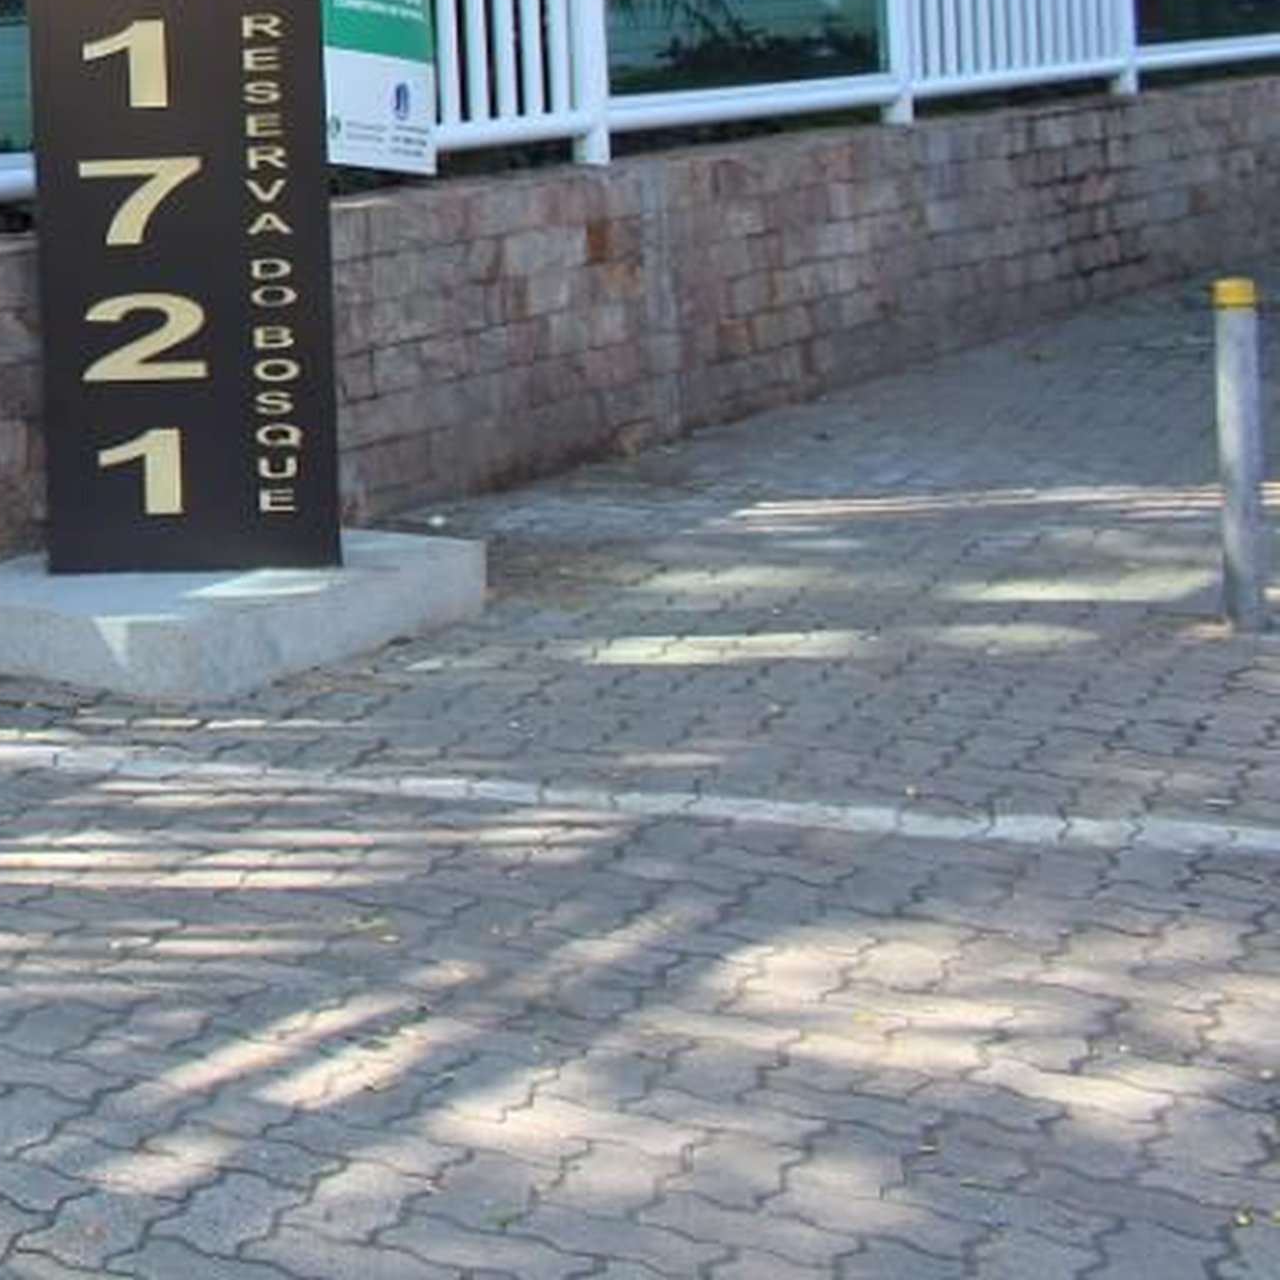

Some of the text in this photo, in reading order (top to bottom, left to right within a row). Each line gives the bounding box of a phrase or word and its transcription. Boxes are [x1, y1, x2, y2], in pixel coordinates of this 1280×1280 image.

[241, 13, 303, 513] RESERVA DO BOSQUE
